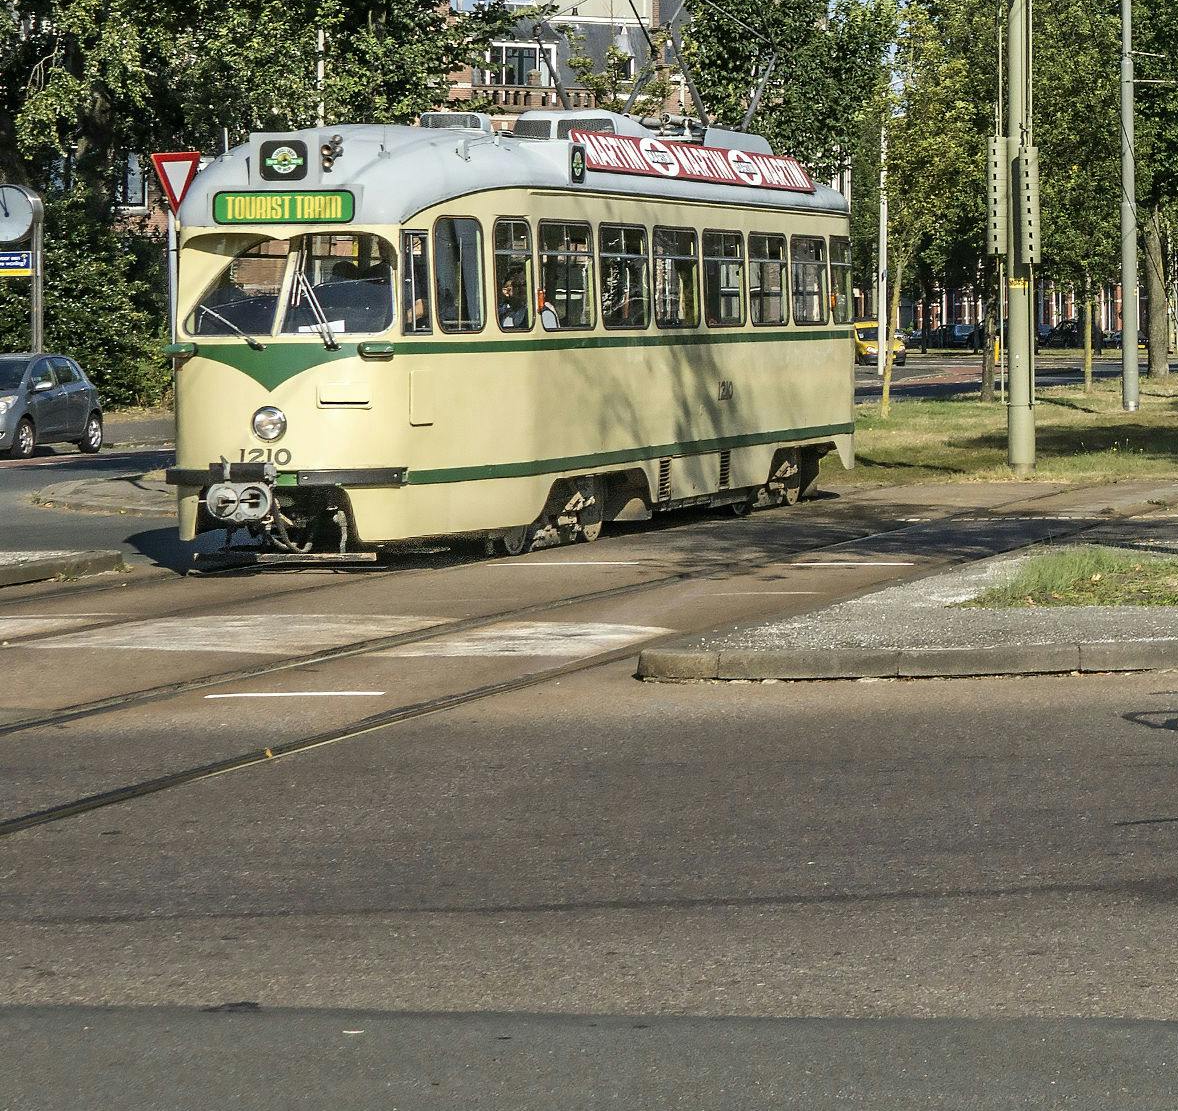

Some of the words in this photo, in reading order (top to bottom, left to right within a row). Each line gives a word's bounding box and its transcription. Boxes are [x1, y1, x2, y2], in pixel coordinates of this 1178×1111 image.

[575, 132, 650, 171] MARTINI
[670, 144, 737, 181] MARTINI
[752, 155, 811, 188] MARTINI
[225, 196, 292, 219] TOURIST
[294, 195, 342, 219] TRAM
[718, 381, 734, 401] 1210
[239, 448, 292, 466] 1210
